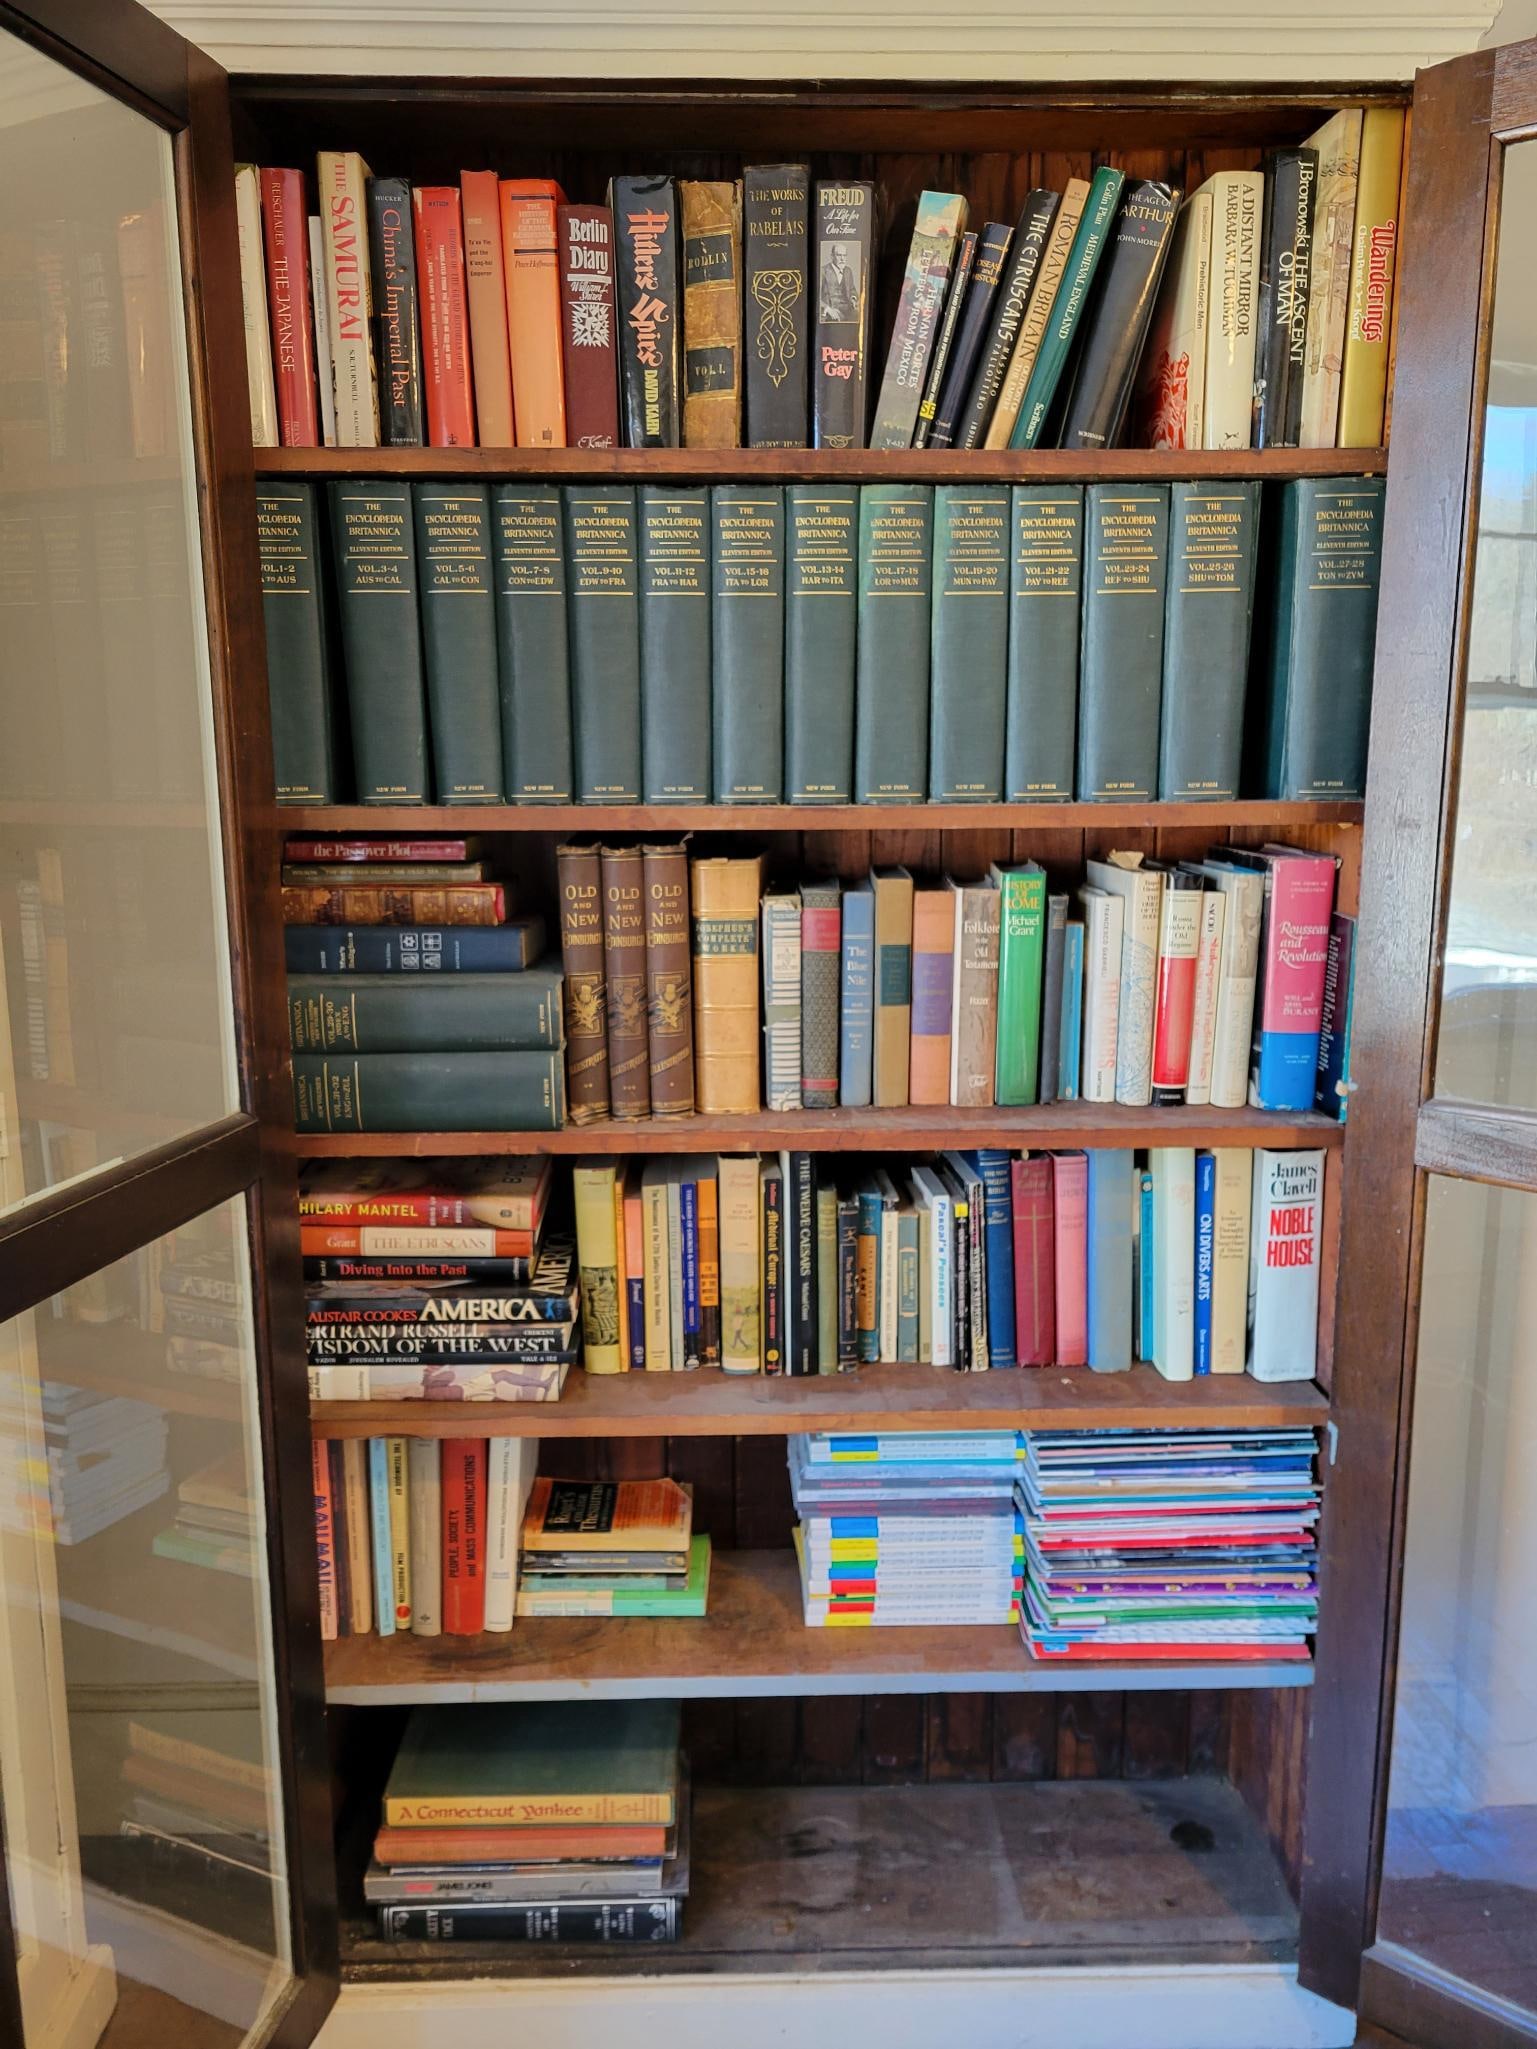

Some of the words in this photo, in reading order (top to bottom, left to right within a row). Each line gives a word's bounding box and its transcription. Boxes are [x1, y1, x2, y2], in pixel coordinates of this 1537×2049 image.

[332, 160, 347, 192] THE
[750, 190, 770, 202] THE
[771, 188, 804, 201] WORKS
[1100, 181, 1115, 208] Colin
[1242, 183, 1254, 194] A
[819, 188, 865, 207] FREUD
[1127, 193, 1147, 203] THE
[1148, 194, 1162, 205] AGE
[271, 181, 284, 246] REISCHAUER
[770, 206, 783, 216] OF
[824, 210, 833, 220] A
[833, 208, 850, 222] Life
[1094, 207, 1108, 225] Platt
[1119, 204, 1174, 225] ARTHUR
[1226, 184, 1238, 248] BARBARA
[568, 218, 608, 244] Berlin
[750, 220, 804, 236] RABELAIS
[825, 223, 840, 234] Our
[840, 223, 857, 234] Time
[1026, 213, 1050, 244] THE
[1241, 195, 1254, 266] DISTANT
[380, 208, 399, 282] China's
[1117, 234, 1136, 244] JOHN
[627, 208, 670, 291] Hitler's
[1046, 211, 1078, 288] ROMAN
[1226, 250, 1237, 265] W.
[329, 195, 364, 342] SAMURAI
[569, 246, 609, 275] Diary
[1071, 232, 1100, 296] MEDIEVAL
[1279, 251, 1294, 275] OF
[273, 256, 290, 288] THE
[915, 250, 934, 302] LETTERS
[1293, 253, 1309, 288] THE
[1198, 260, 1206, 308] Prehistoric
[1366, 219, 1396, 343] Wanderings
[998, 246, 1039, 342] ETRUSCANS
[1222, 266, 1237, 338] TUCHMAN
[1240, 268, 1252, 337] MIRROR
[1277, 276, 1292, 326] MAN
[908, 301, 924, 339] FROM
[919, 286, 938, 341] HERNAN
[1058, 295, 1081, 341] ENGLAND
[276, 293, 296, 374] JAPANESE
[384, 284, 410, 368] Imperial
[628, 293, 670, 367] Spies
[1020, 289, 1052, 362] BRITAIN
[1290, 290, 1308, 365] ASCENT
[822, 347, 858, 363] Peter
[896, 339, 915, 386] MEXICO
[824, 362, 853, 380] Gay
[976, 342, 1002, 410] PALLOTTINO
[350, 365, 359, 402] TURNBULL
[392, 369, 412, 408] Past
[644, 370, 658, 402] DAVID
[645, 402, 660, 436] KAHN
[1026, 401, 1045, 441] Scribners
[364, 503, 382, 511] THE
[444, 503, 460, 511] THE
[348, 527, 401, 536] BRITANNICA
[428, 527, 480, 537] BRITANNICA
[504, 529, 554, 538] BRITANNICA
[576, 530, 626, 540] BRITANNICA
[650, 530, 700, 540] BRITANNICA
[722, 530, 772, 540] BRITANNICA
[798, 529, 848, 538] BRITANNICA
[872, 530, 921, 540] BRITANNICA
[951, 530, 1000, 540] BRITANNICA
[1022, 530, 1072, 539] BRITANNICA
[1104, 528, 1152, 537] BRITANNICA
[1187, 526, 1238, 536] BRITANNICA
[1318, 523, 1370, 532] BRITANNICA
[357, 564, 398, 574] VOL.3-4
[435, 564, 476, 573] VOL.5-6
[356, 576, 375, 584] AUS
[384, 576, 402, 584] CAL
[433, 576, 452, 584] CAL
[460, 576, 480, 584] CON
[313, 844, 333, 857] the
[388, 844, 411, 857] Plot
[566, 884, 597, 900] OLD
[651, 884, 682, 900] OLD
[1002, 879, 1041, 891] HISTORY
[608, 887, 640, 902] OLD
[1014, 889, 1028, 900] OF
[572, 902, 592, 910] AND
[616, 904, 635, 912] AND
[659, 901, 678, 909] AND
[1004, 898, 1041, 910] ROME
[566, 914, 600, 928] NEW
[608, 916, 642, 930] NEW
[652, 913, 684, 928] NEW
[964, 920, 1000, 936] Folklore
[1006, 915, 1040, 927] Michael
[1009, 925, 1035, 936] Grant
[1280, 921, 1329, 939] Rousseau
[1280, 937, 1303, 948] and
[847, 946, 867, 957] The
[974, 948, 988, 958] Old
[1278, 950, 1328, 970] Revolution
[847, 960, 868, 971] Blue
[965, 959, 998, 970] Testament
[847, 974, 866, 986] Nile
[800, 1158, 811, 1181] THE
[1271, 1162, 1318, 1178] James
[1270, 1178, 1317, 1198] Clavell
[299, 1204, 352, 1216] HILARY
[358, 1204, 418, 1217] MANTEL
[800, 1182, 812, 1228] TWELVE
[938, 1202, 946, 1257] Pascal's
[1200, 1214, 1212, 1232] ON
[1270, 1206, 1315, 1236] NOBLE
[327, 1236, 357, 1249] Grant
[372, 1238, 402, 1250] THE
[407, 1236, 488, 1249] ETRUSCANS
[800, 1228, 812, 1277] CAESARS
[1200, 1232, 1212, 1272] DIVERS
[1266, 1238, 1314, 1268] HOUSE
[340, 1264, 384, 1278] Diving
[387, 1264, 414, 1275] Into
[416, 1264, 436, 1275] the
[440, 1264, 467, 1276] Past
[1198, 1272, 1211, 1301] ARTS
[308, 1310, 362, 1322] ALISTAIR
[418, 1298, 545, 1322] AMERICA
[402, 1323, 484, 1338] RUSSELL
[396, 1338, 426, 1354] OF
[431, 1338, 484, 1354] THE
[488, 1337, 556, 1353] WEST
[464, 1454, 476, 1534] COMMUNICATIONS
[466, 1537, 476, 1560] MASS
[466, 1564, 477, 1576] and
[400, 1808, 412, 1821] A
[416, 1804, 514, 1820] Connecticut
[520, 1803, 583, 1821] Yankee
